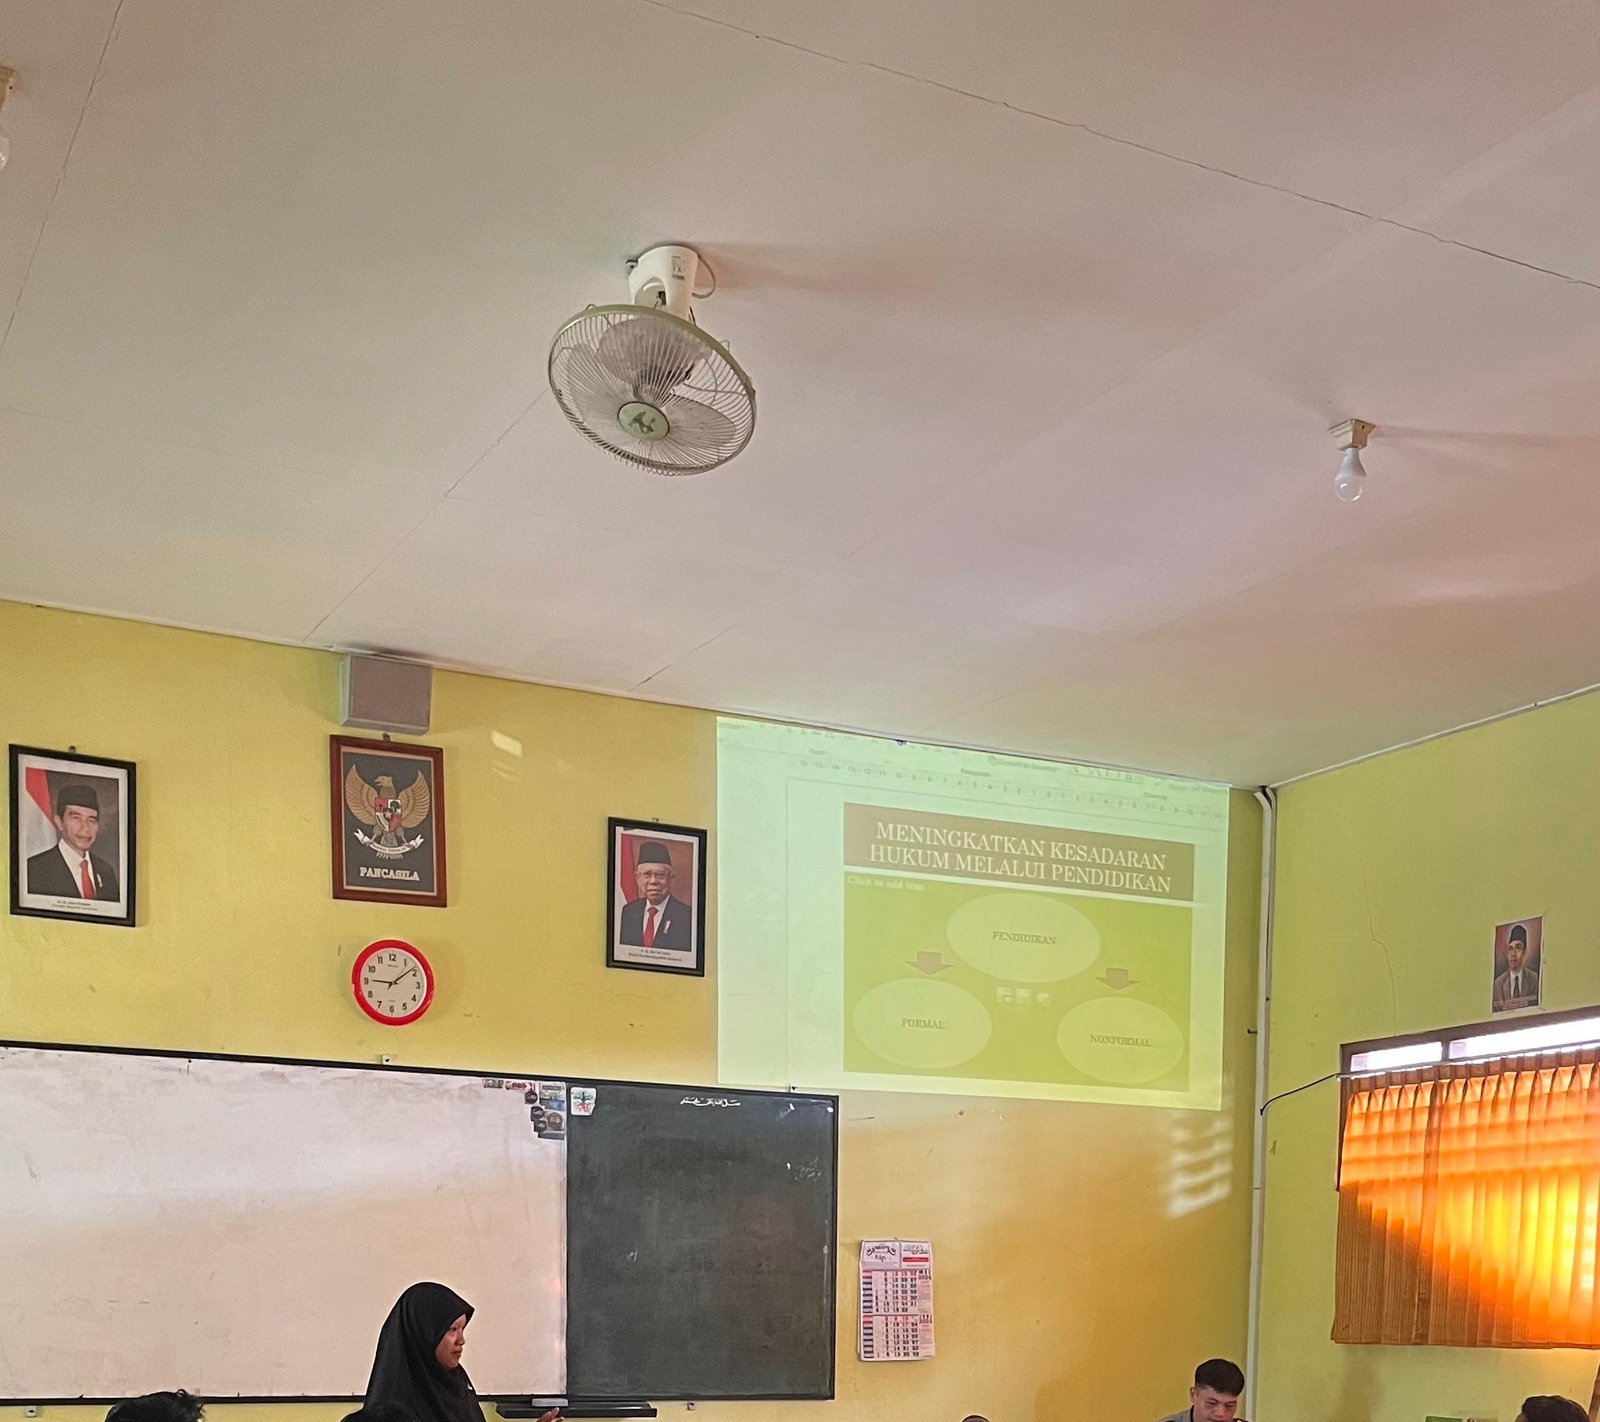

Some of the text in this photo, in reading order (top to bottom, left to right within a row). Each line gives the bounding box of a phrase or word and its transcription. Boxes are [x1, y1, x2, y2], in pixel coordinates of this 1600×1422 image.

[876, 822, 1166, 871] MENINGKATKAN KESADARAN
[869, 844, 1171, 893] HUKUM MELALUI PENDIDIKAN
[359, 866, 420, 881] PANCASILA
[388, 953, 397, 961] 12
[368, 965, 376, 973] 10
[364, 977, 369, 985] 9
[411, 994, 417, 1002] 4
[377, 1001, 382, 1009] 7
